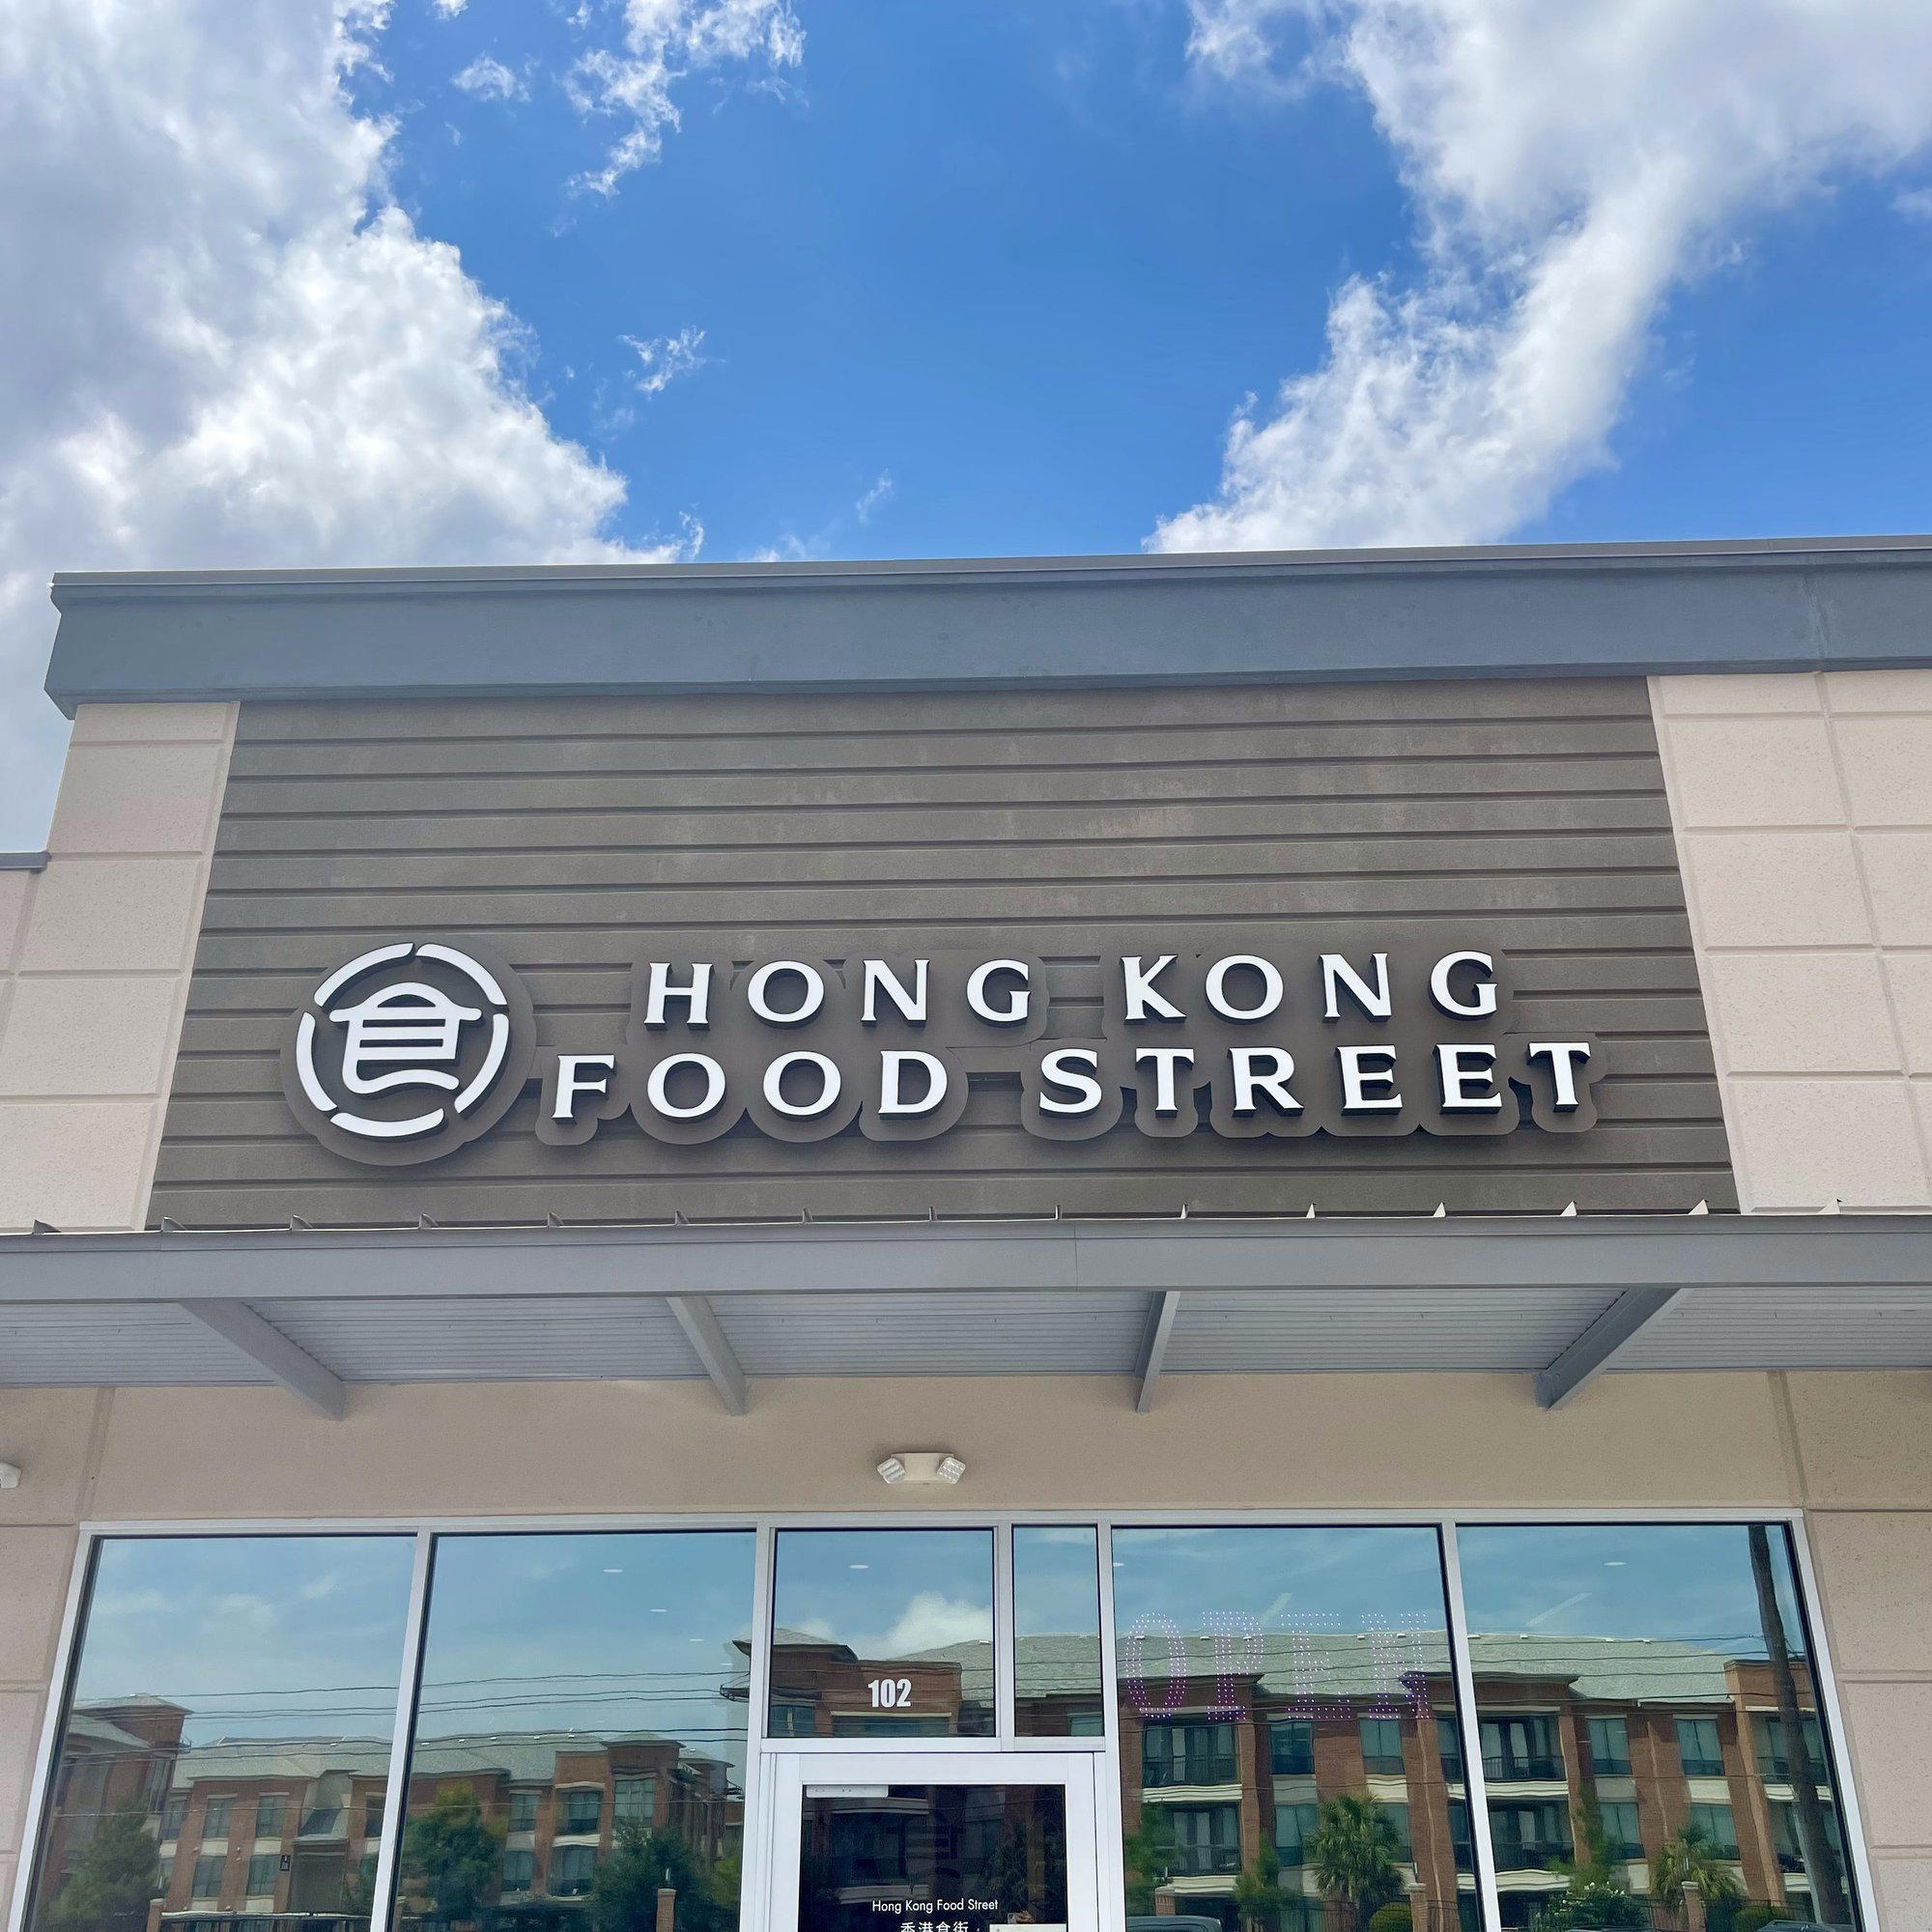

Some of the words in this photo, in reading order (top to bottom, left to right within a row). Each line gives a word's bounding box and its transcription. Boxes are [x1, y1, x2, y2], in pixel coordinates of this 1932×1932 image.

[643, 958, 1032, 1025] HONG
[1120, 951, 1498, 1021] KONG
[552, 1049, 948, 1120] FOOD
[1038, 1041, 1592, 1114] STREET
[867, 1678, 912, 1708] 102
[1125, 1607, 1430, 1721] OPEN
[872, 1899, 901, 1915] Hong
[905, 1899, 933, 1915] Kong
[937, 1898, 964, 1911] Food
[967, 1898, 999, 1911] Street
